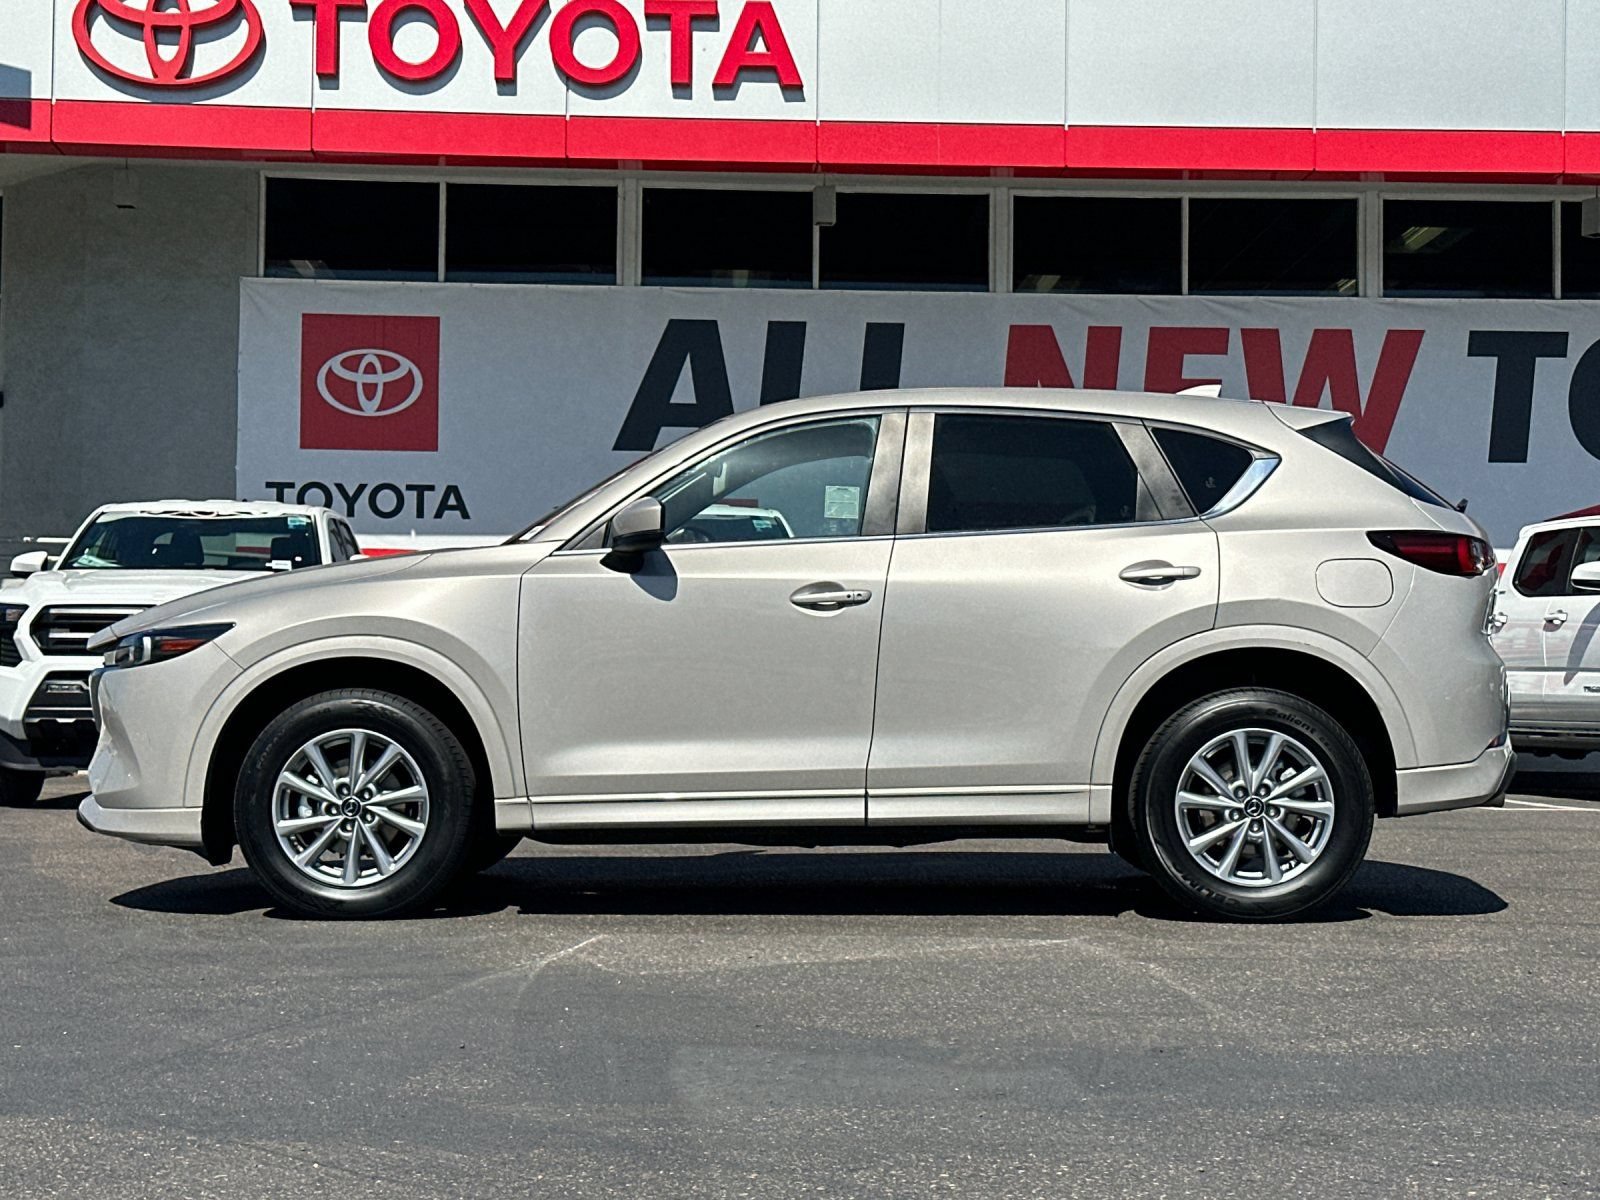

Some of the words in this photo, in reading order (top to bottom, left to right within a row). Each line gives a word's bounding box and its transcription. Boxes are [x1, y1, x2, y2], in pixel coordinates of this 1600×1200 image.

[290, 0, 804, 88] TOYOTA
[1467, 330, 1600, 463] T
[265, 481, 471, 520] TOYOTA
